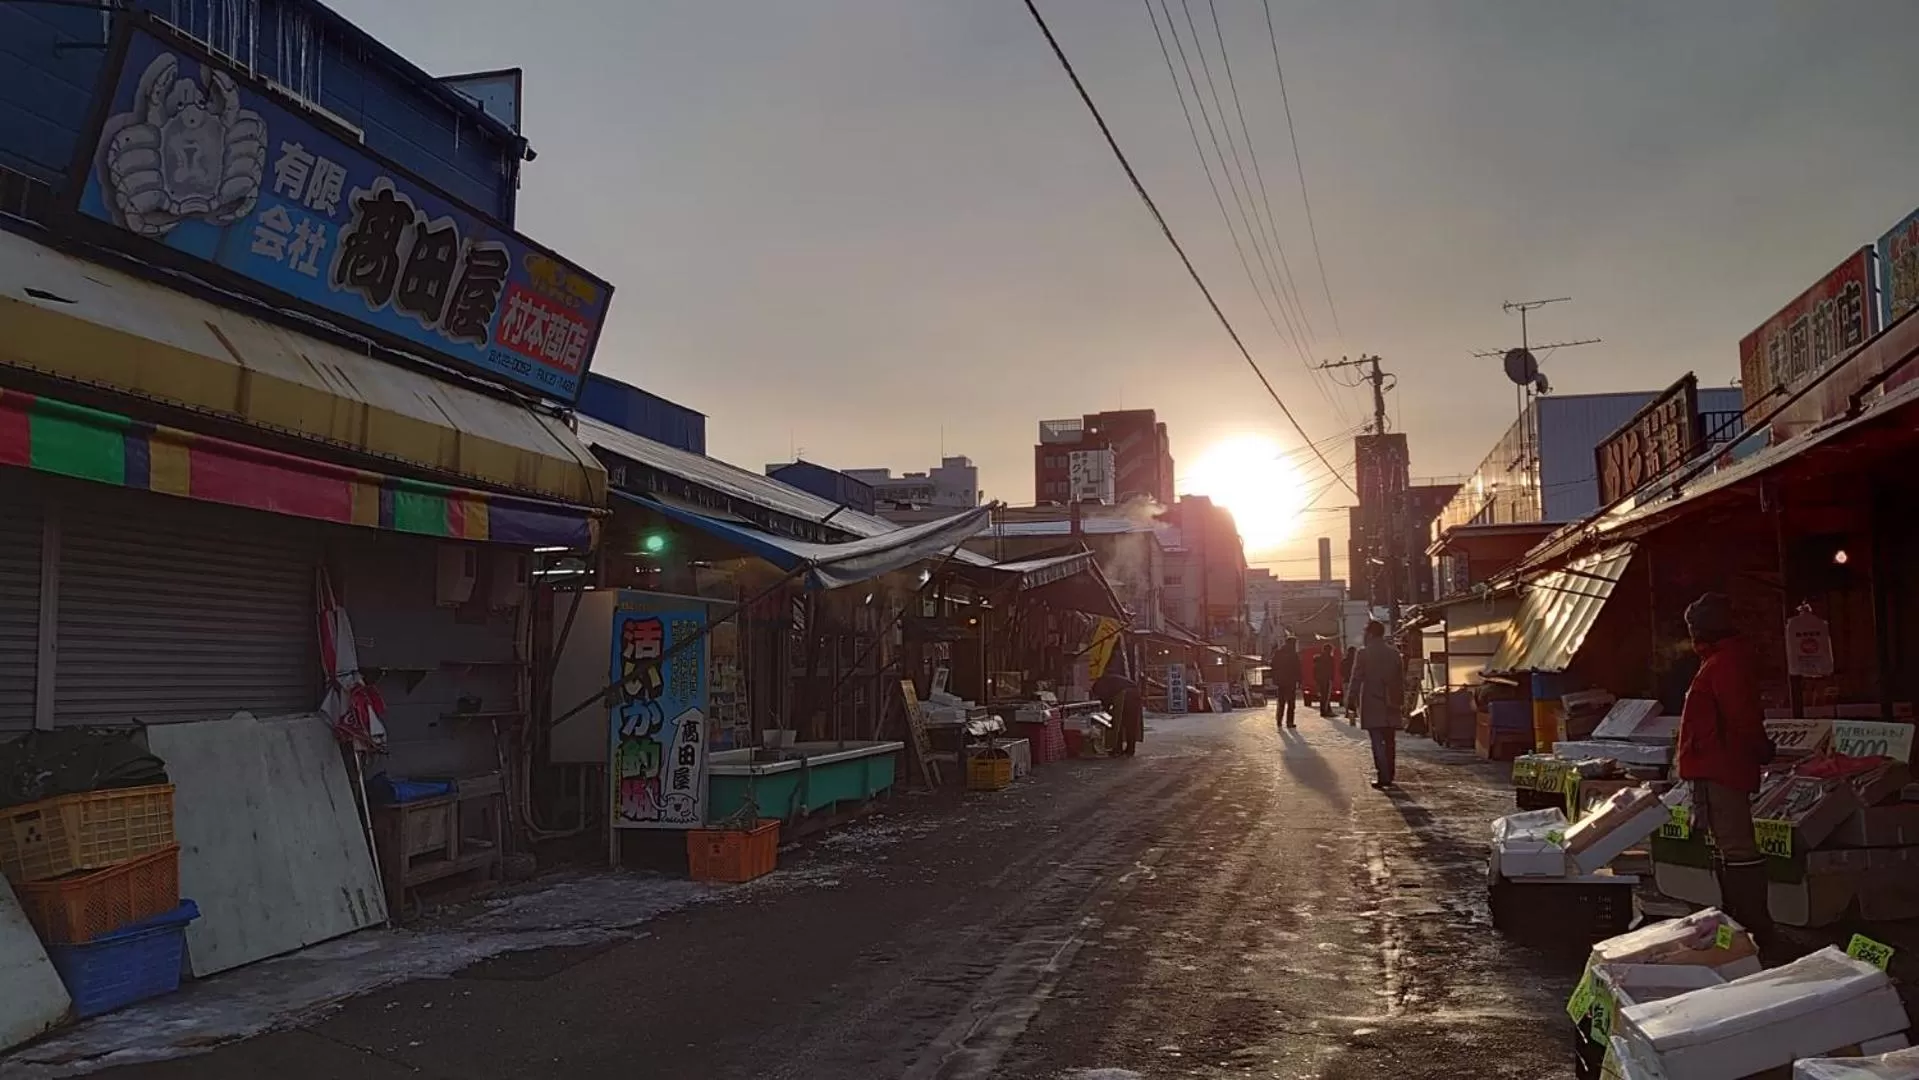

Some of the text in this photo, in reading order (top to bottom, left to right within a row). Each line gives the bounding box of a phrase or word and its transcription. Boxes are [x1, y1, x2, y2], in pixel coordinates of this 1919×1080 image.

[271, 140, 349, 217] 有限
[249, 204, 331, 280] 会社
[502, 291, 588, 370] 村本商店
[672, 720, 699, 790] 高田屋
